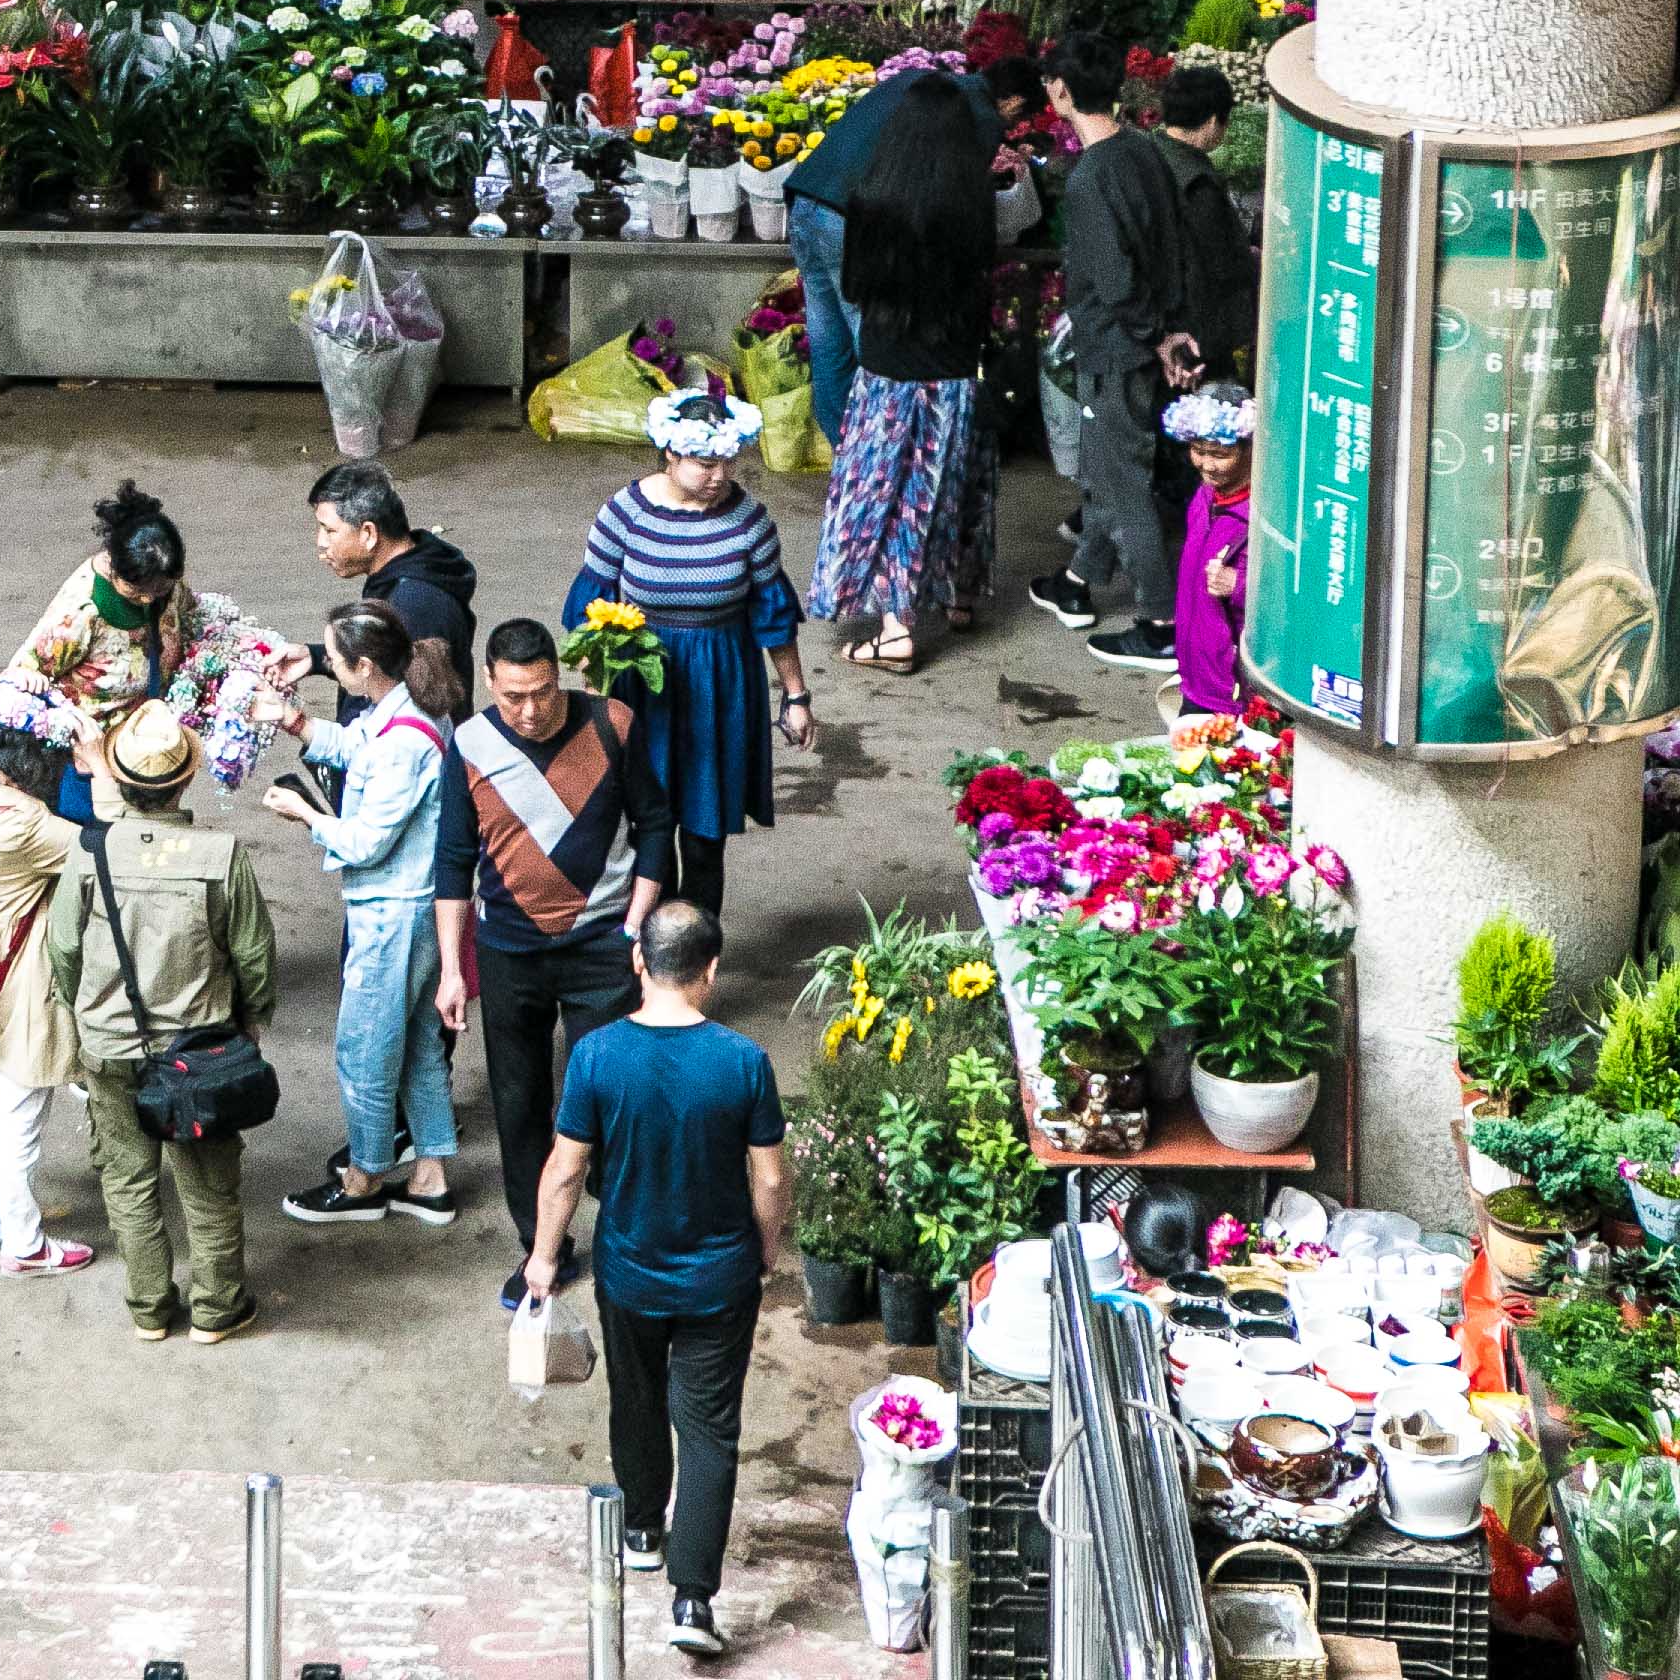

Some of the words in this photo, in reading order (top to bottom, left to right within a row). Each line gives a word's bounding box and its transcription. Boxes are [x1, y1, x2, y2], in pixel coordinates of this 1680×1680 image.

[1491, 189, 1547, 209] 1HF
[1554, 217, 1612, 239] 卫生间
[1483, 412, 1520, 432] 3F
